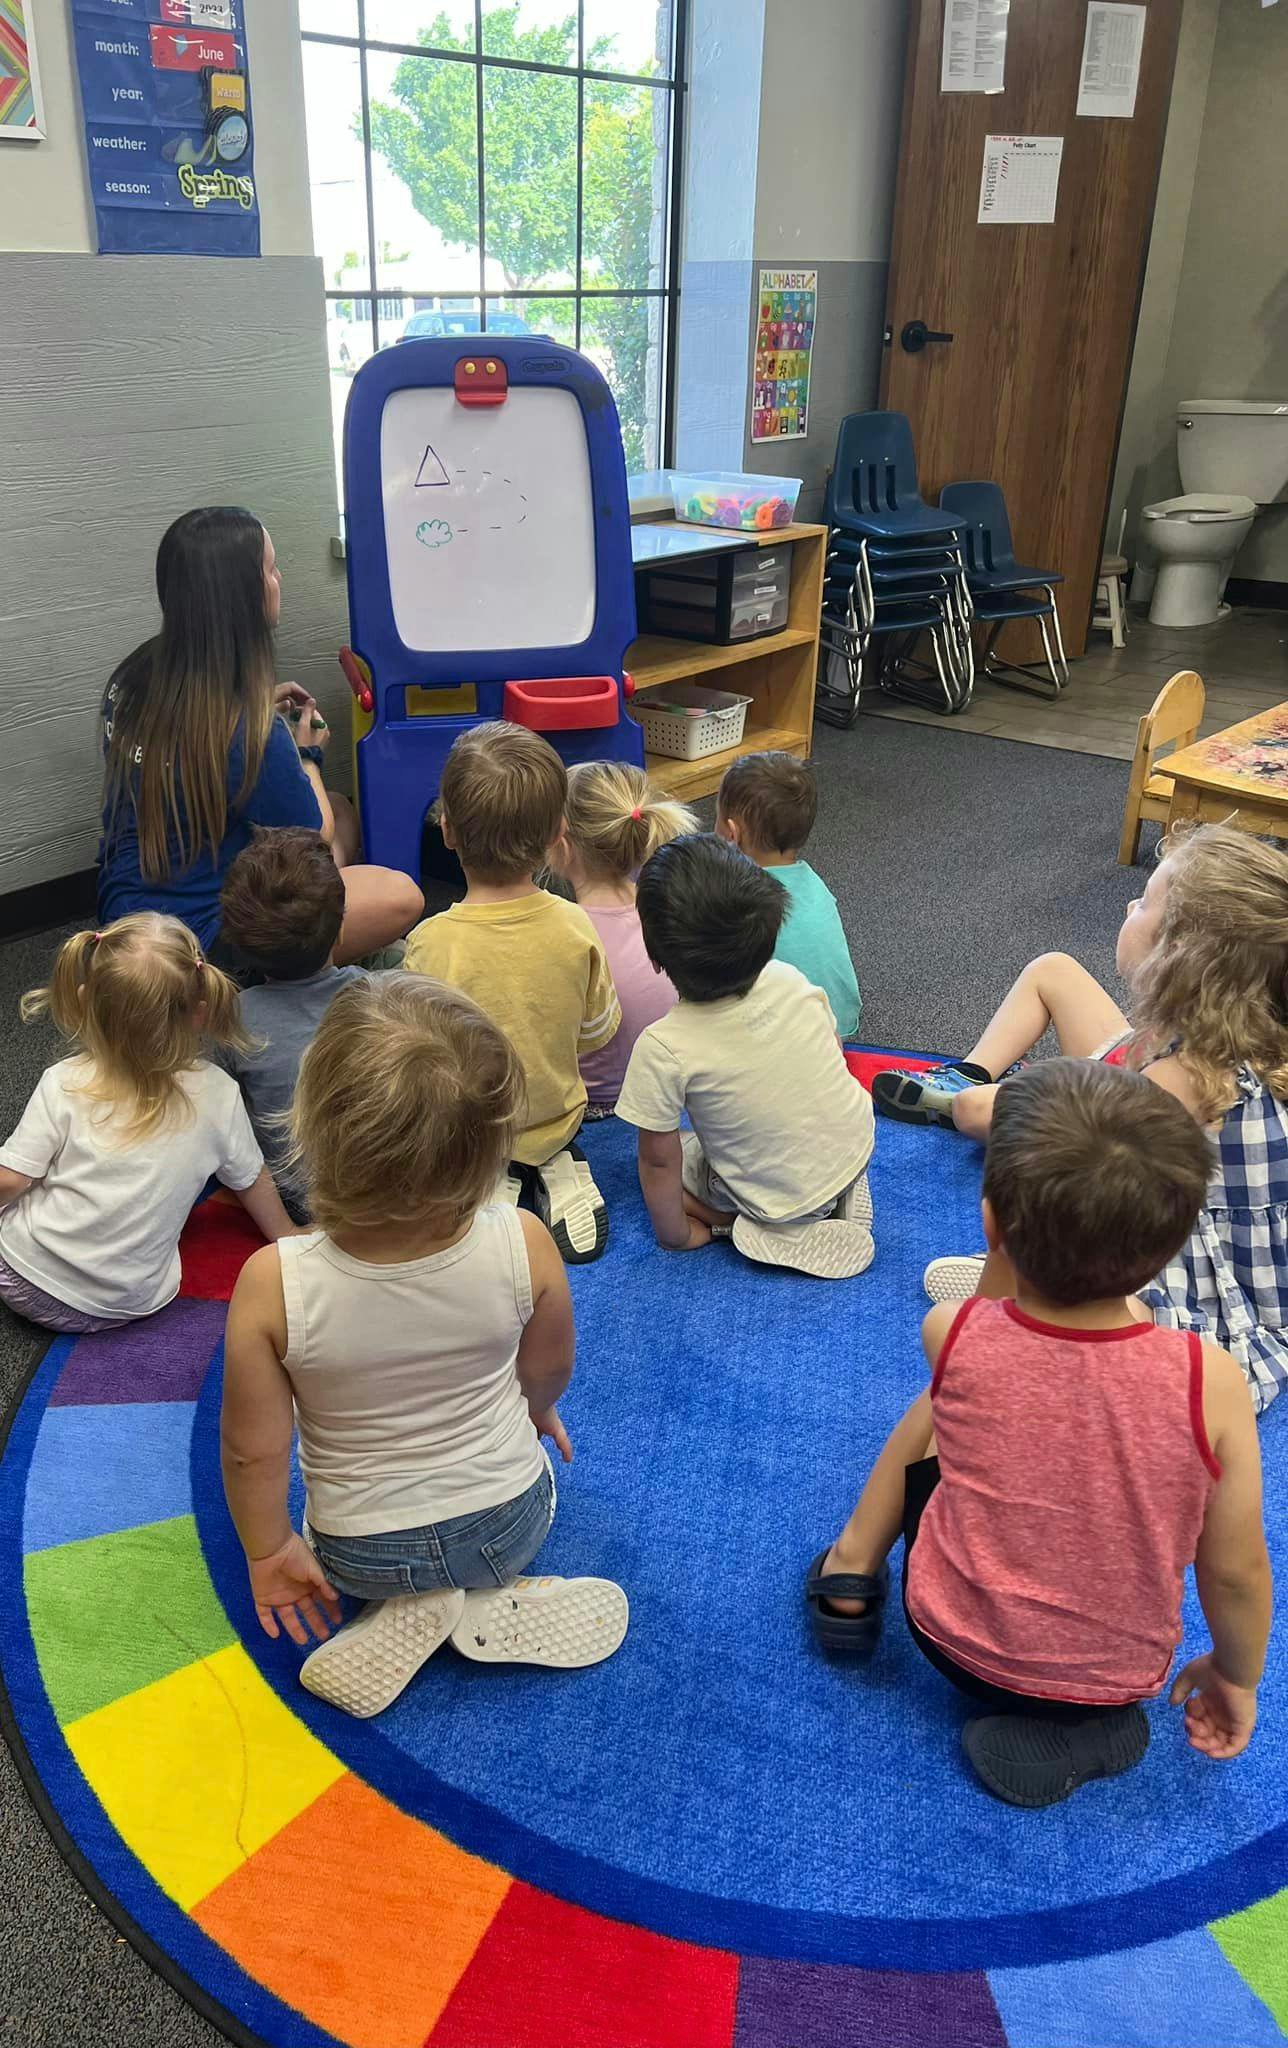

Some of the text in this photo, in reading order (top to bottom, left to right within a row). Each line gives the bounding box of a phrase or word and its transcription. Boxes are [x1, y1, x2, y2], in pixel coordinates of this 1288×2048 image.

[95, 40, 140, 57] month:
[198, 45, 224, 61] June
[112, 85, 144, 102] year:
[92, 135, 147, 152] weather:
[105, 180, 151, 194] season:
[179, 165, 254, 208] Spring
[762, 272, 806, 289] ALPHABET
